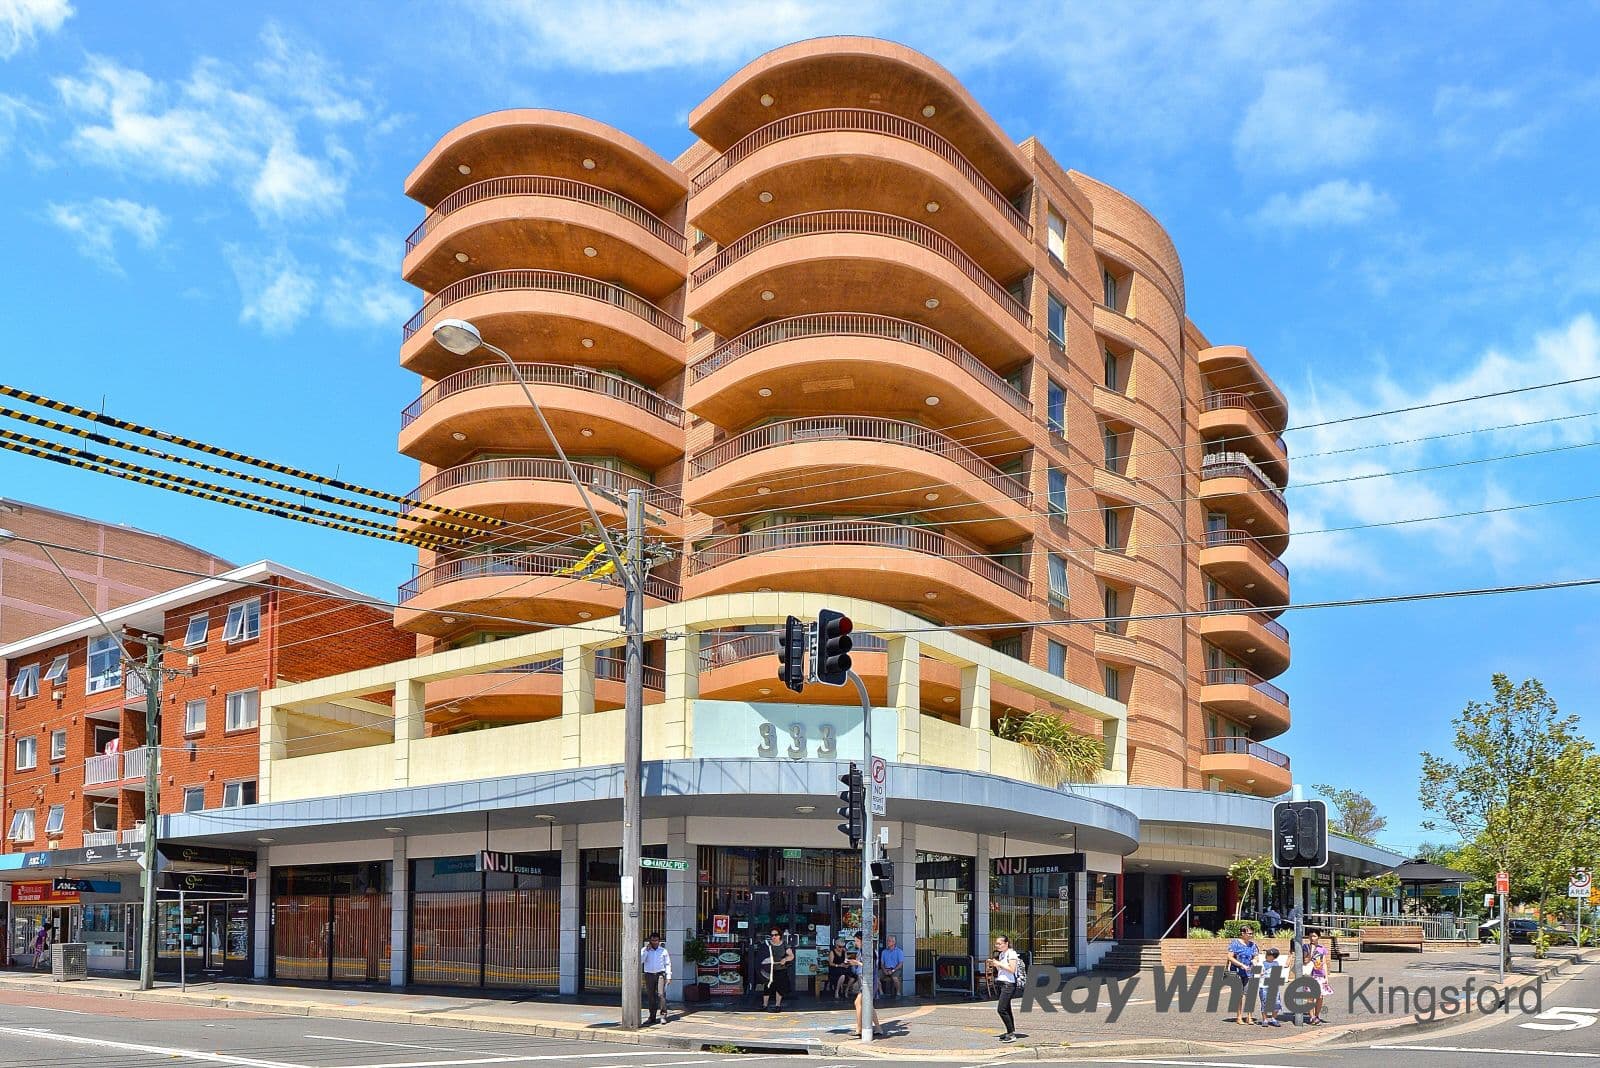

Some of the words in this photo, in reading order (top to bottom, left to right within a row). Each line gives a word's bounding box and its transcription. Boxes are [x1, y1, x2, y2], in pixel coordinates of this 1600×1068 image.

[757, 723, 837, 759] 333
[874, 785, 882, 795] NO
[28, 857, 40, 866] ANZ
[483, 851, 513, 872] NIJI
[514, 866, 530, 874] SUSHI
[653, 860, 673, 869] ANZAC
[674, 861, 685, 869] PDE
[996, 858, 1027, 875] NIJI
[1028, 866, 1045, 874] SUSHI
[56, 882, 77, 890] ANZ
